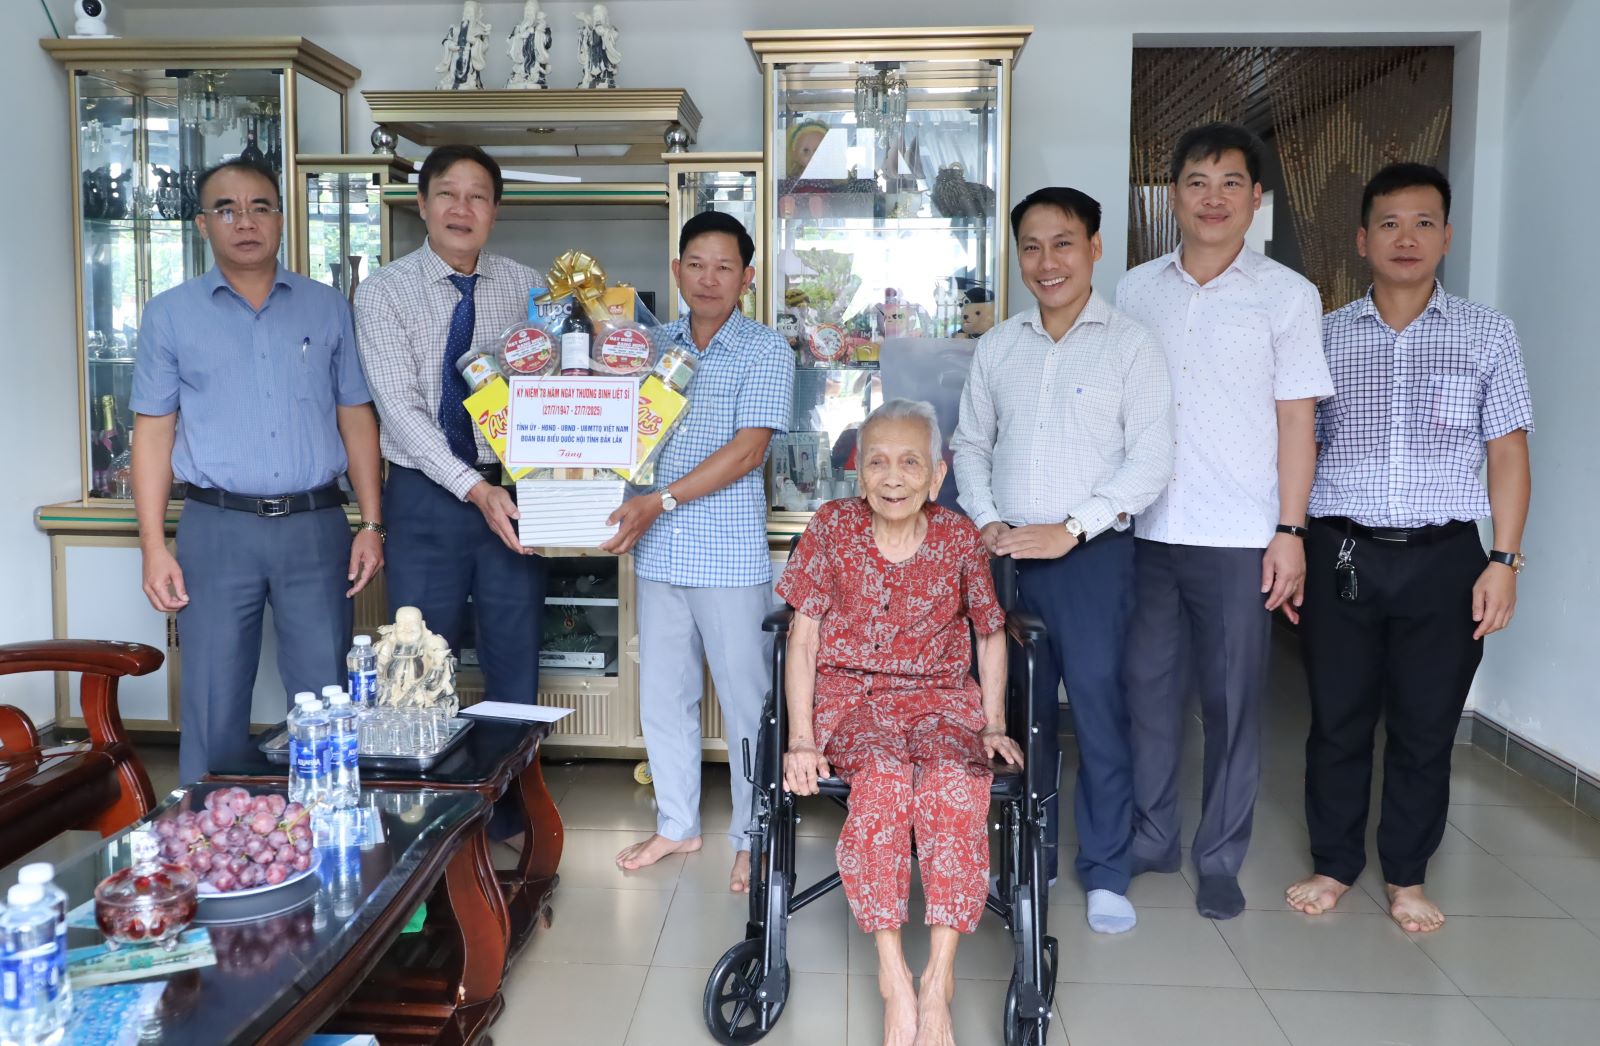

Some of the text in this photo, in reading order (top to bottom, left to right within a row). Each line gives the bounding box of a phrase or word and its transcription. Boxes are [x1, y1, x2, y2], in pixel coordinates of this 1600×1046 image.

[525, 386, 539, 399] NIỆM
[540, 387, 547, 398] 78
[598, 388, 611, 399] BINH
[542, 405, 570, 416] (27/7/1947
[574, 405, 602, 416] 27/7/2025)
[560, 424, 576, 432] UBND
[603, 424, 615, 433] VIỆT
